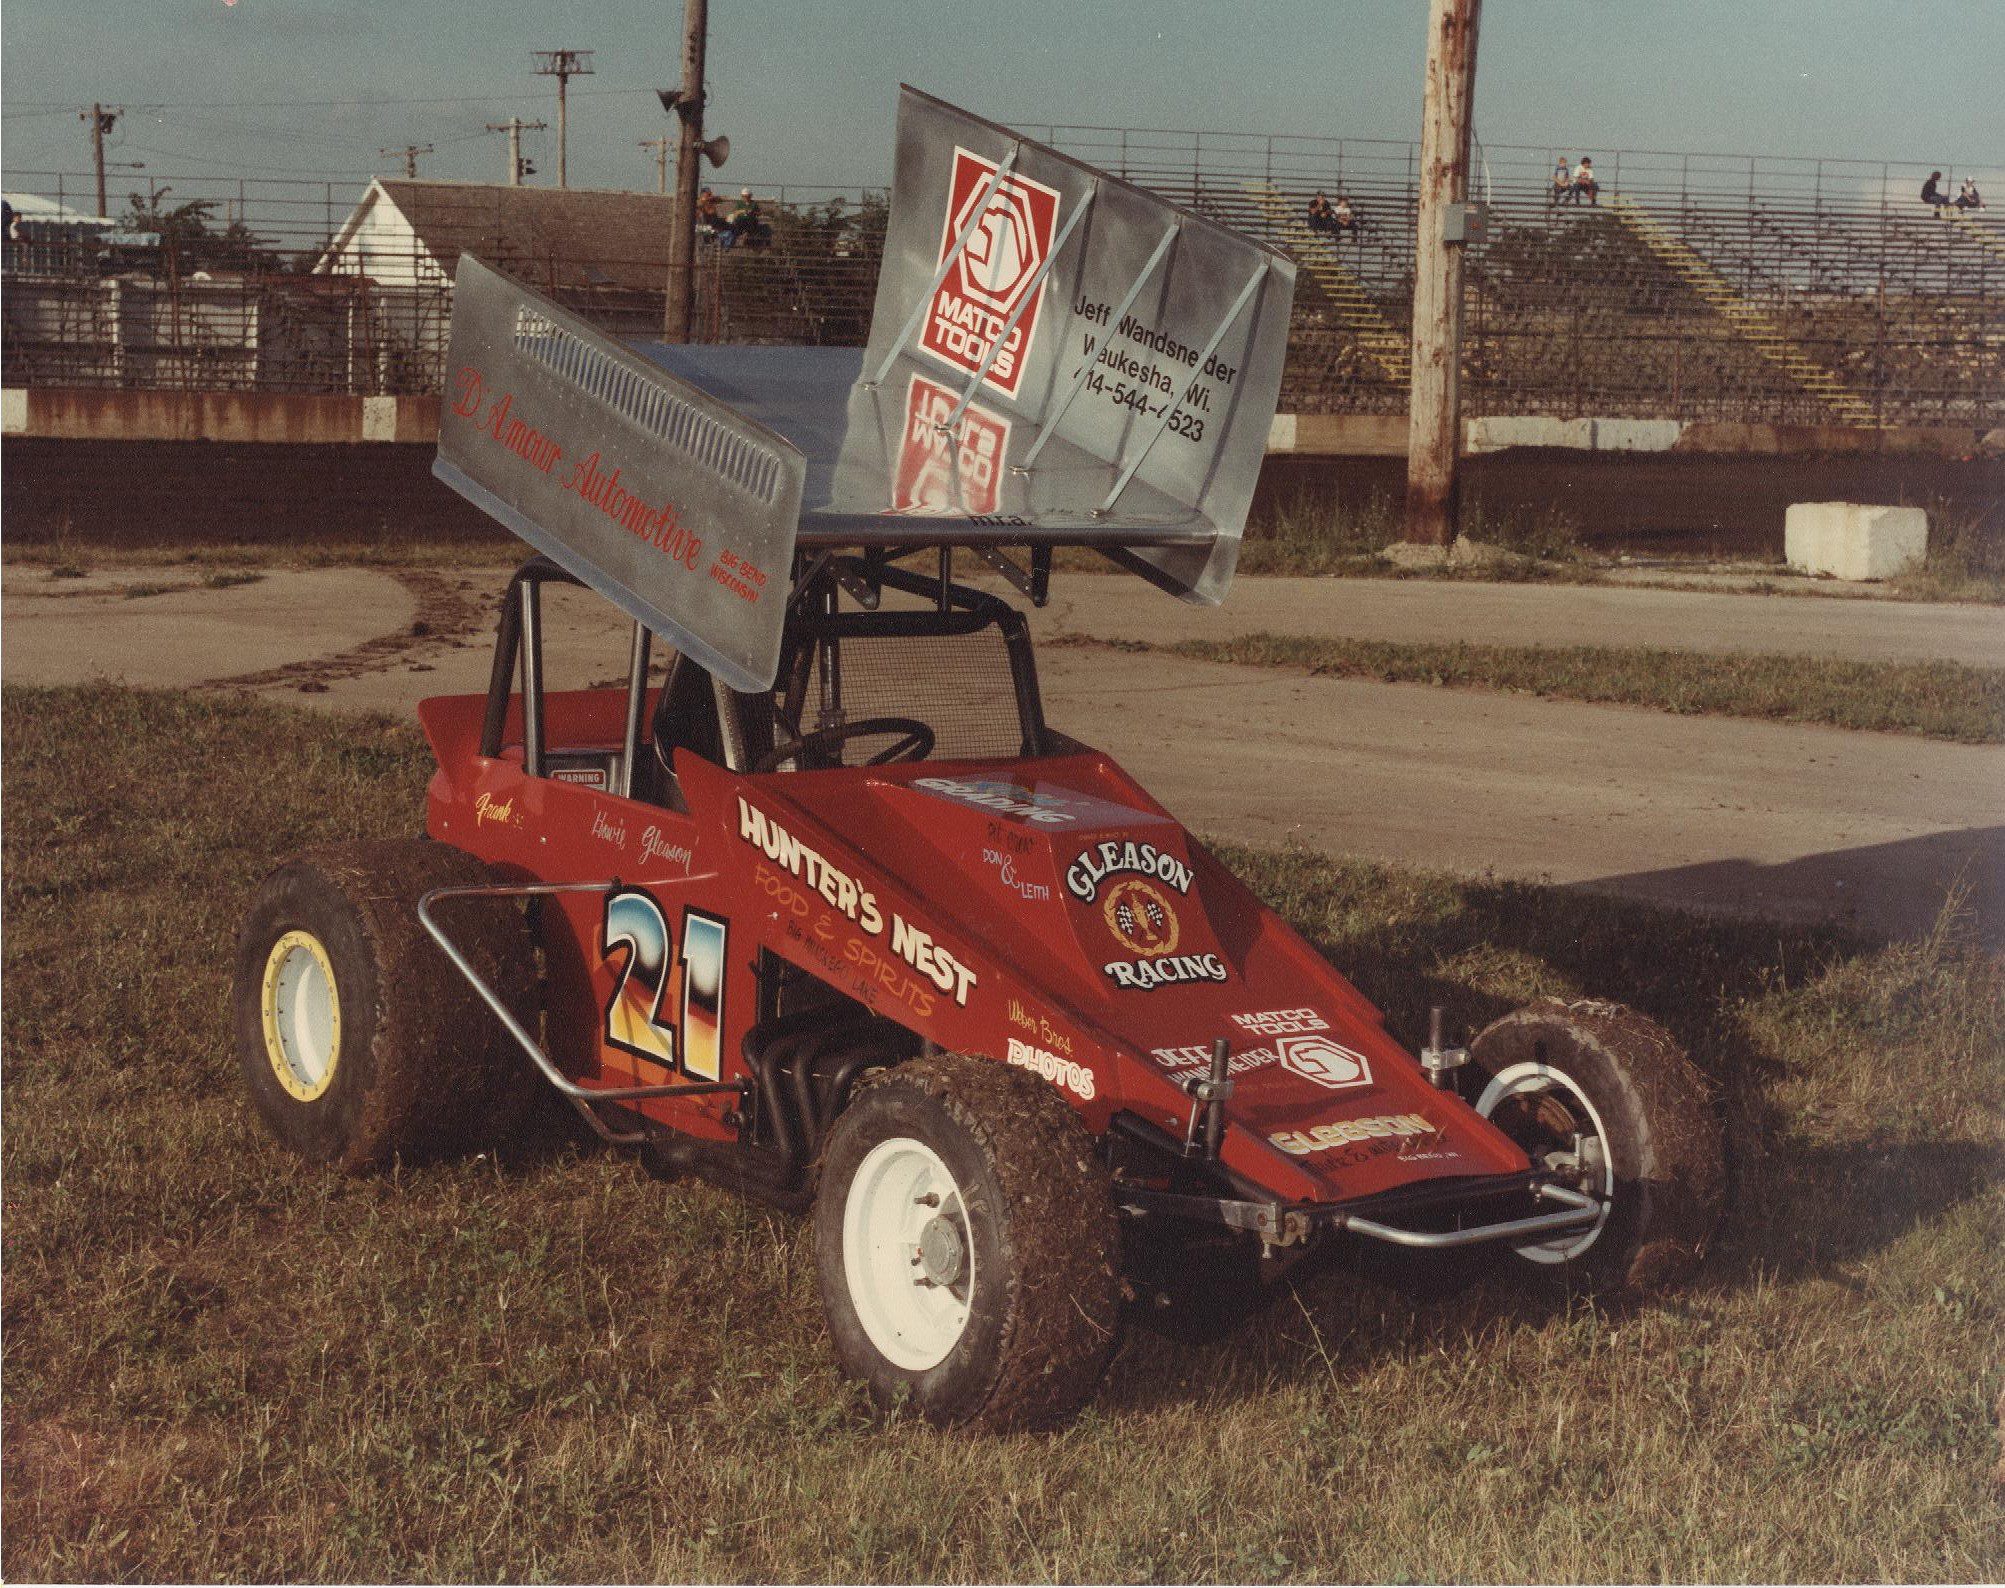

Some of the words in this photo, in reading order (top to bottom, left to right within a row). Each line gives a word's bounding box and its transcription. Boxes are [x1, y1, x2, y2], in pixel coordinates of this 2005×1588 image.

[937, 291, 1022, 352] MATCO
[1075, 296, 1111, 326] Jeff
[1119, 315, 1237, 384] Wandsneder
[934, 316, 1015, 378] TOOLS
[1186, 384, 1210, 412] Wi.
[559, 451, 702, 571] Automotive
[720, 549, 739, 568] BIG
[710, 563, 759, 602] WISCONSIN
[559, 773, 600, 783] WARNING
[475, 792, 513, 828] Frank
[638, 825, 692, 876] Gleason
[983, 848, 1003, 865] DON
[1001, 854, 1020, 889] &
[1066, 840, 1194, 903] GLEASON
[737, 796, 884, 935] HUNTER'S
[892, 913, 977, 1007] NEST
[755, 863, 809, 917] FOOD
[813, 914, 834, 941] &
[844, 938, 935, 1018] SPIRITS
[601, 884, 730, 1083] 21
[1104, 953, 1228, 989] RACING
[1231, 1007, 1319, 1025] MATCO
[1242, 1018, 1331, 1036] TOOLS
[1006, 1037, 1096, 1100] PHOTOS
[1151, 1045, 1213, 1067] JEFF
